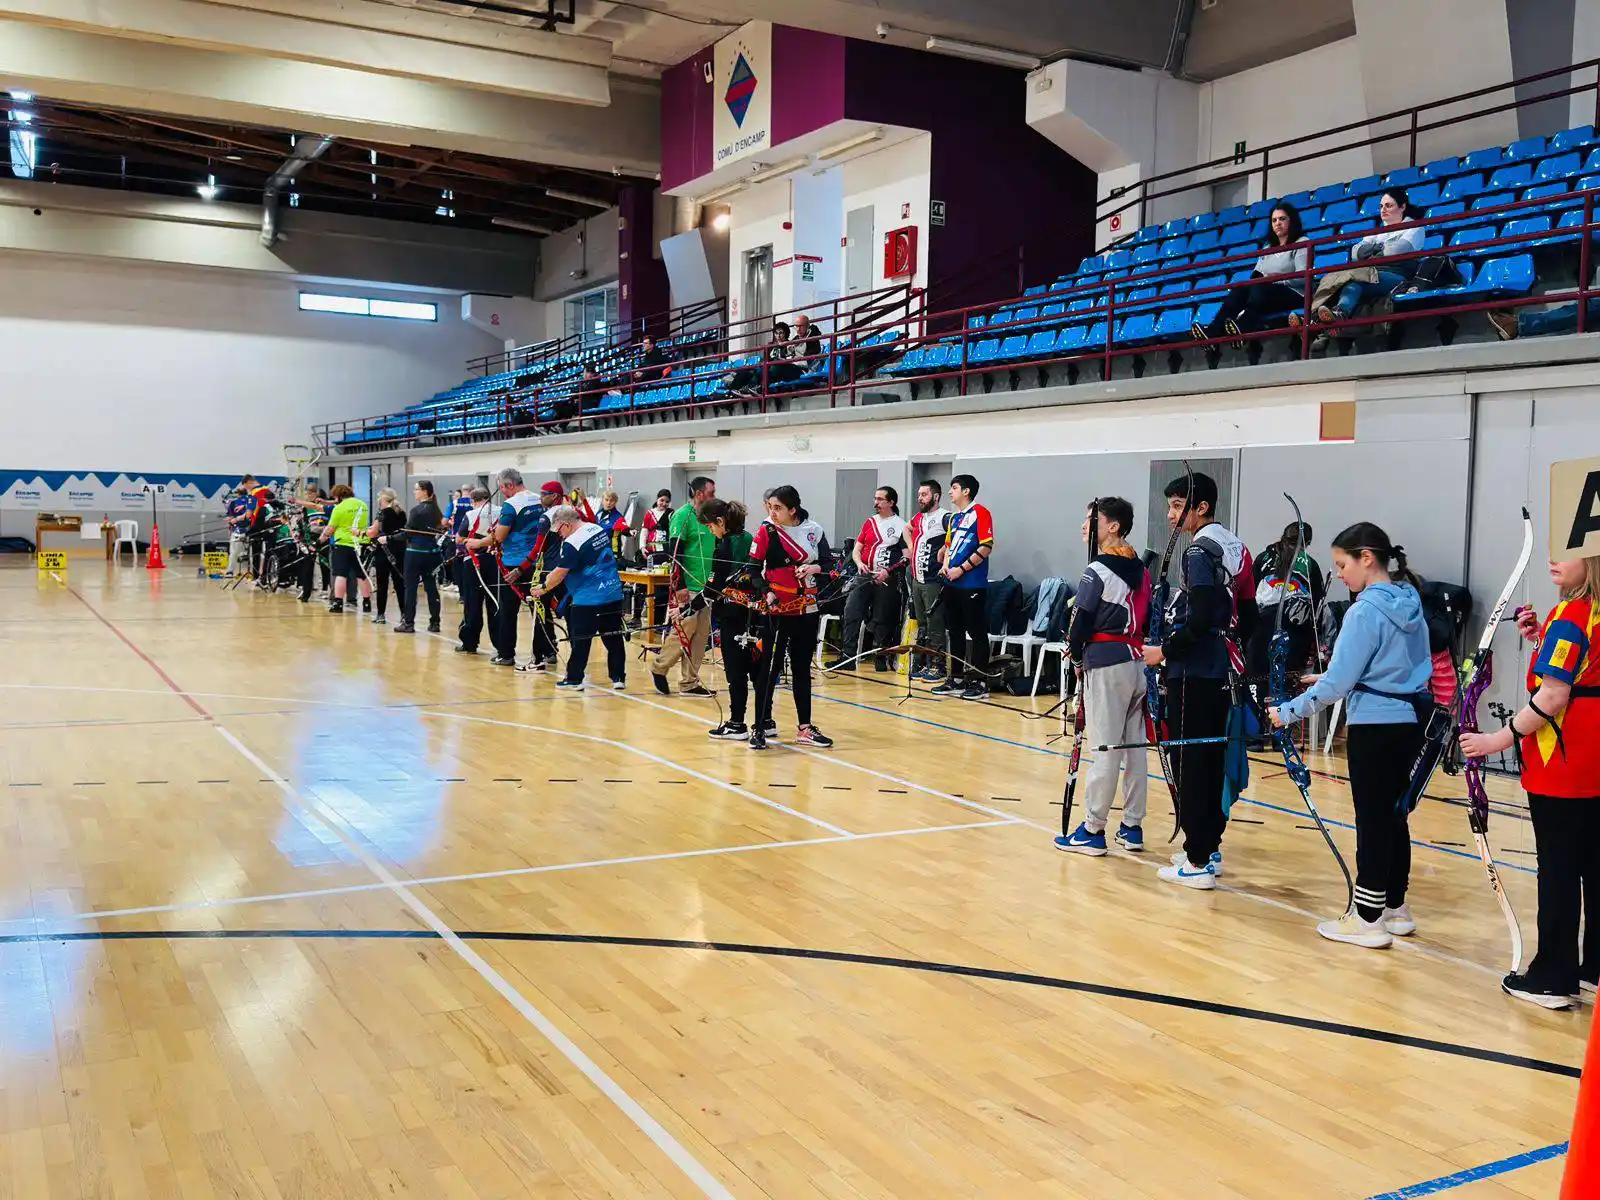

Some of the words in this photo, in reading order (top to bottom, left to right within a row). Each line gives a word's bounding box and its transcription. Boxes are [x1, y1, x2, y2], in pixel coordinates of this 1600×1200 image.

[735, 130, 766, 152] D'ENCAMP
[143, 485, 150, 493] A
[1566, 470, 1600, 549] A
